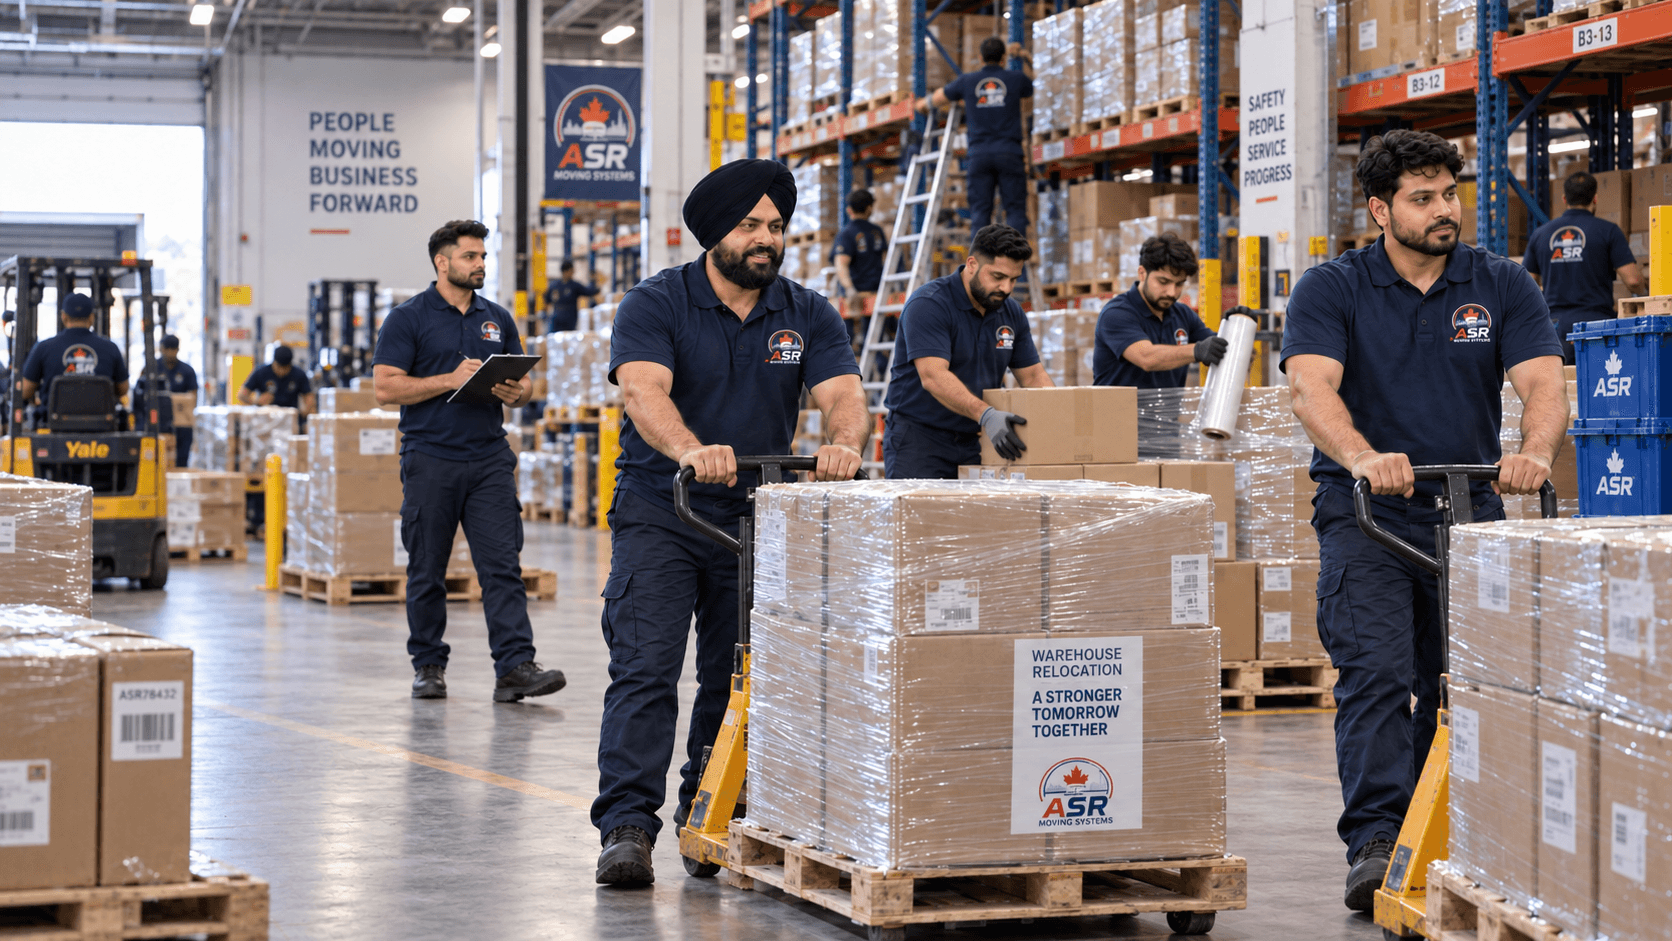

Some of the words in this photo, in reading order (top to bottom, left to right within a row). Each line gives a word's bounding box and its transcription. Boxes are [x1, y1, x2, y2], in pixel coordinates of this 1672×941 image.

[1578, 25, 1612, 47] B3-13
[1412, 74, 1440, 93] B3-12
[1248, 88, 1286, 112] SAFETY
[309, 111, 395, 132] PEOPLE
[1249, 114, 1285, 137] PEOPLE
[309, 139, 401, 159] MOVING
[557, 143, 629, 170] ASR
[1248, 139, 1286, 161] SERVICE
[309, 166, 418, 186] BUSINESS
[553, 170, 592, 181] MOVING
[593, 170, 636, 182] SYSTEMS
[1244, 163, 1292, 187] PROGRESS
[309, 193, 418, 213] FORWARD
[1551, 247, 1583, 260] ASR
[1455, 327, 1490, 339] ASR
[770, 350, 802, 361] ASR
[1593, 376, 1632, 397] ASR
[65, 440, 110, 459] Yale
[1596, 475, 1634, 496] ASR
[1032, 647, 1122, 662] WAREHOUSE
[1033, 663, 1122, 678] RELOCATION
[1032, 690, 1043, 704] A
[1046, 688, 1122, 704] STRONGER
[1032, 705, 1120, 721] TOMORROW
[1032, 722, 1108, 738] TOGETHER
[1042, 796, 1109, 818] ASR
[1039, 818, 1073, 827] MOVING
[1075, 816, 1114, 826] SYSTEMS
